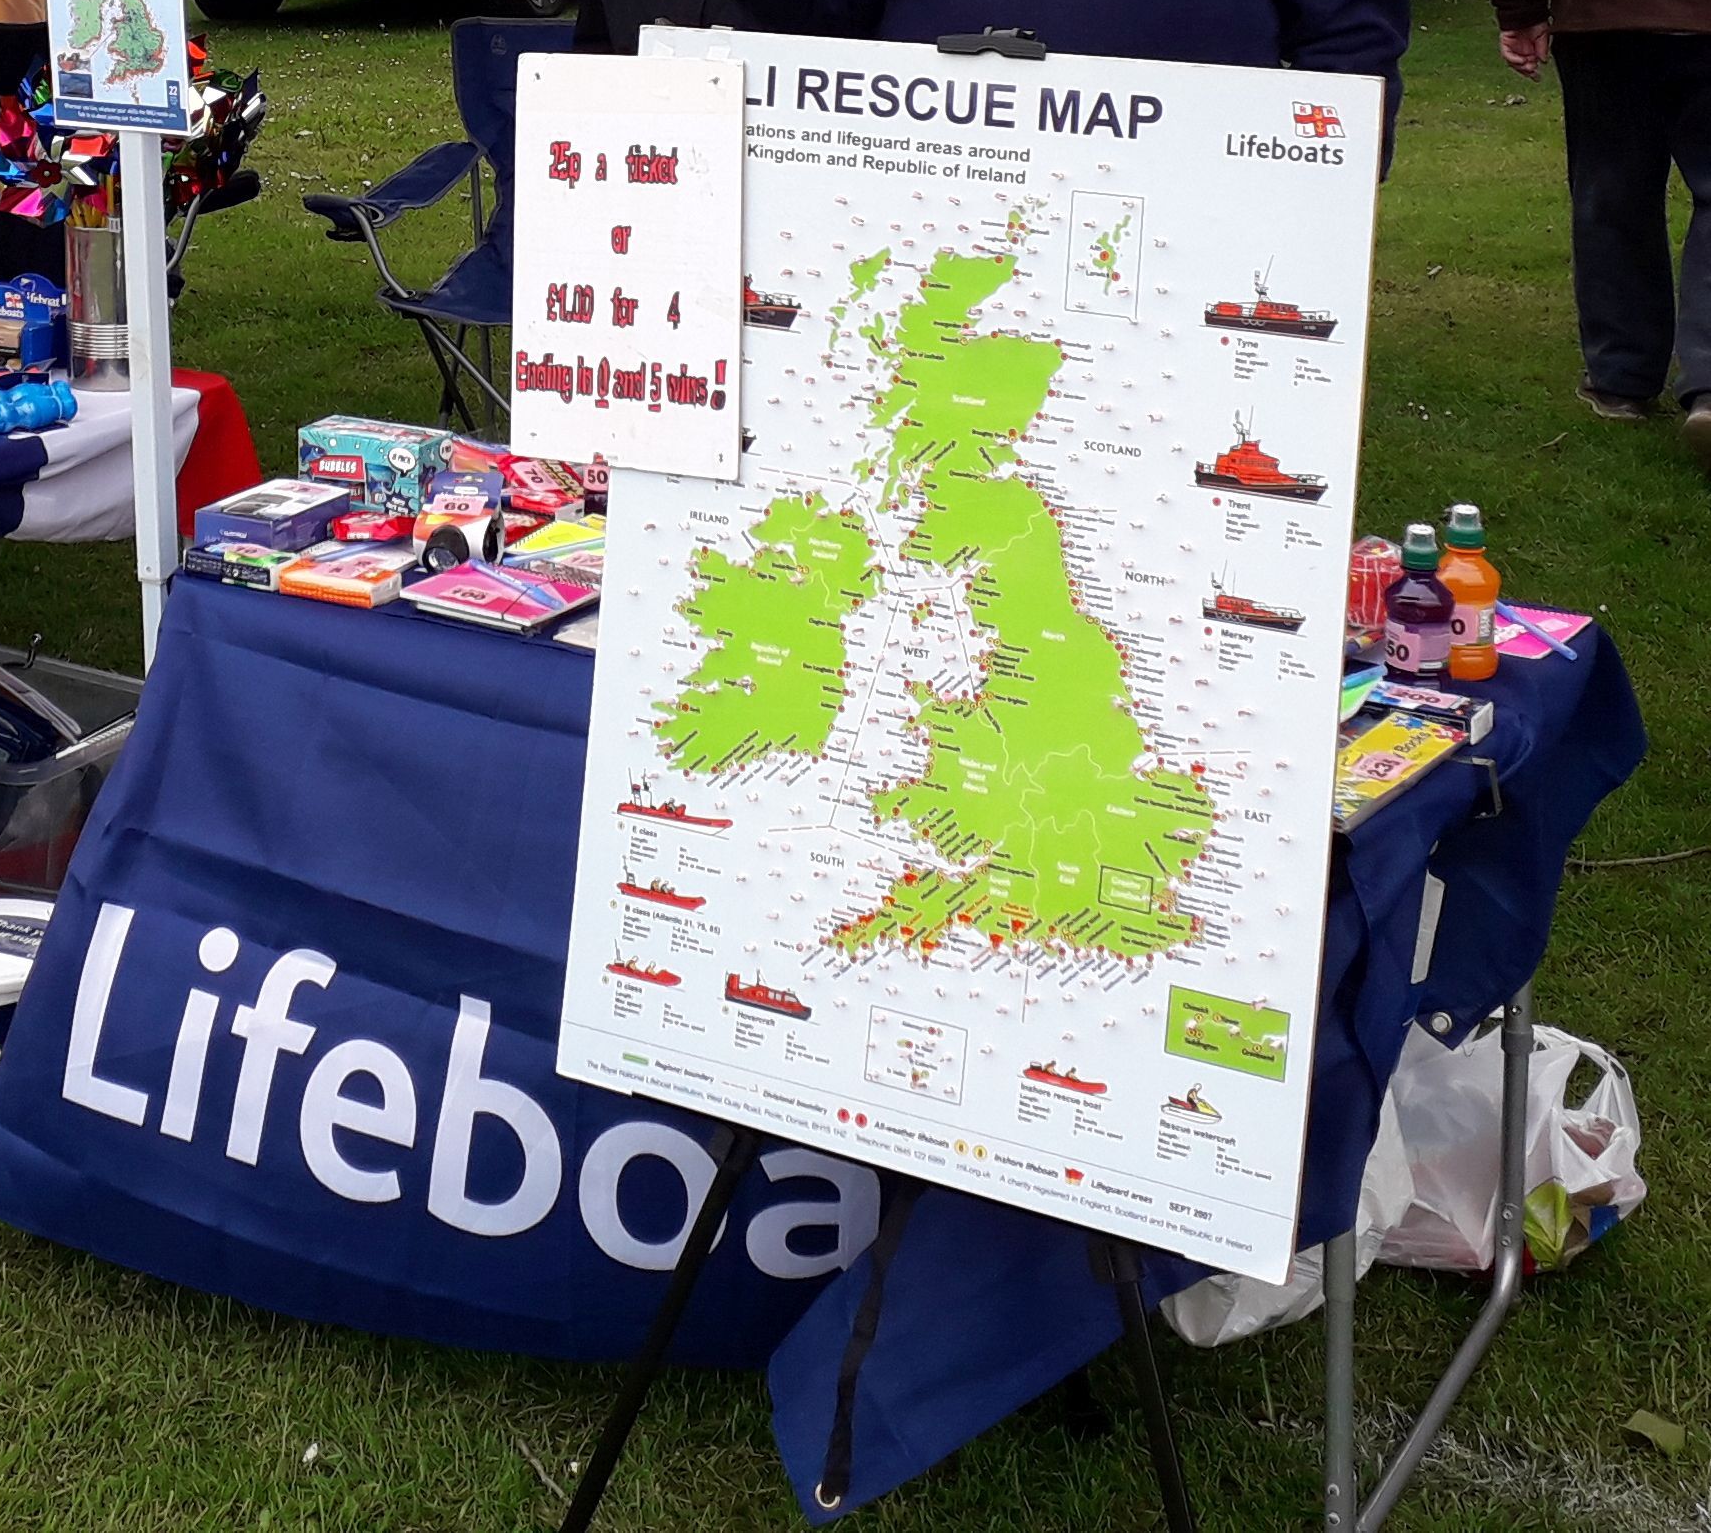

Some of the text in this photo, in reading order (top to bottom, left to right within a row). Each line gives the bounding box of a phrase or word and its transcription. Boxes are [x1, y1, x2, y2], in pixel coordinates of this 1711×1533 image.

[796, 67, 1163, 140] RESCUE MAP
[746, 123, 1031, 163] ations and lifeguard areas around
[1226, 133, 1344, 165] Lifeboats
[549, 141, 678, 188] 25p a ticket
[748, 144, 1026, 185] Kingdom and Republic of Ireland
[611, 224, 632, 255] or
[546, 283, 680, 329] £1.00 for 4
[1237, 338, 1259, 349] Tyne
[516, 350, 573, 404] Ending
[576, 356, 594, 396] in
[612, 362, 646, 402] and
[1084, 440, 1142, 458] SCOTLAND
[319, 460, 357, 474] BUBBLES
[587, 470, 609, 484] 50
[1228, 499, 1251, 511] Trent
[690, 510, 730, 525] IRELAND
[1125, 570, 1165, 586] NORTH
[1221, 628, 1254, 643] Mersey
[903, 645, 930, 659] WEST
[1244, 810, 1272, 824] EAST
[639, 827, 658, 838] class
[810, 852, 845, 868] SOUTH
[632, 906, 651, 918] class
[624, 983, 642, 994] class
[737, 1010, 776, 1027] Hovercraft
[63, 903, 882, 1280] Lifeboa
[1169, 1202, 1192, 1215] SEPT
